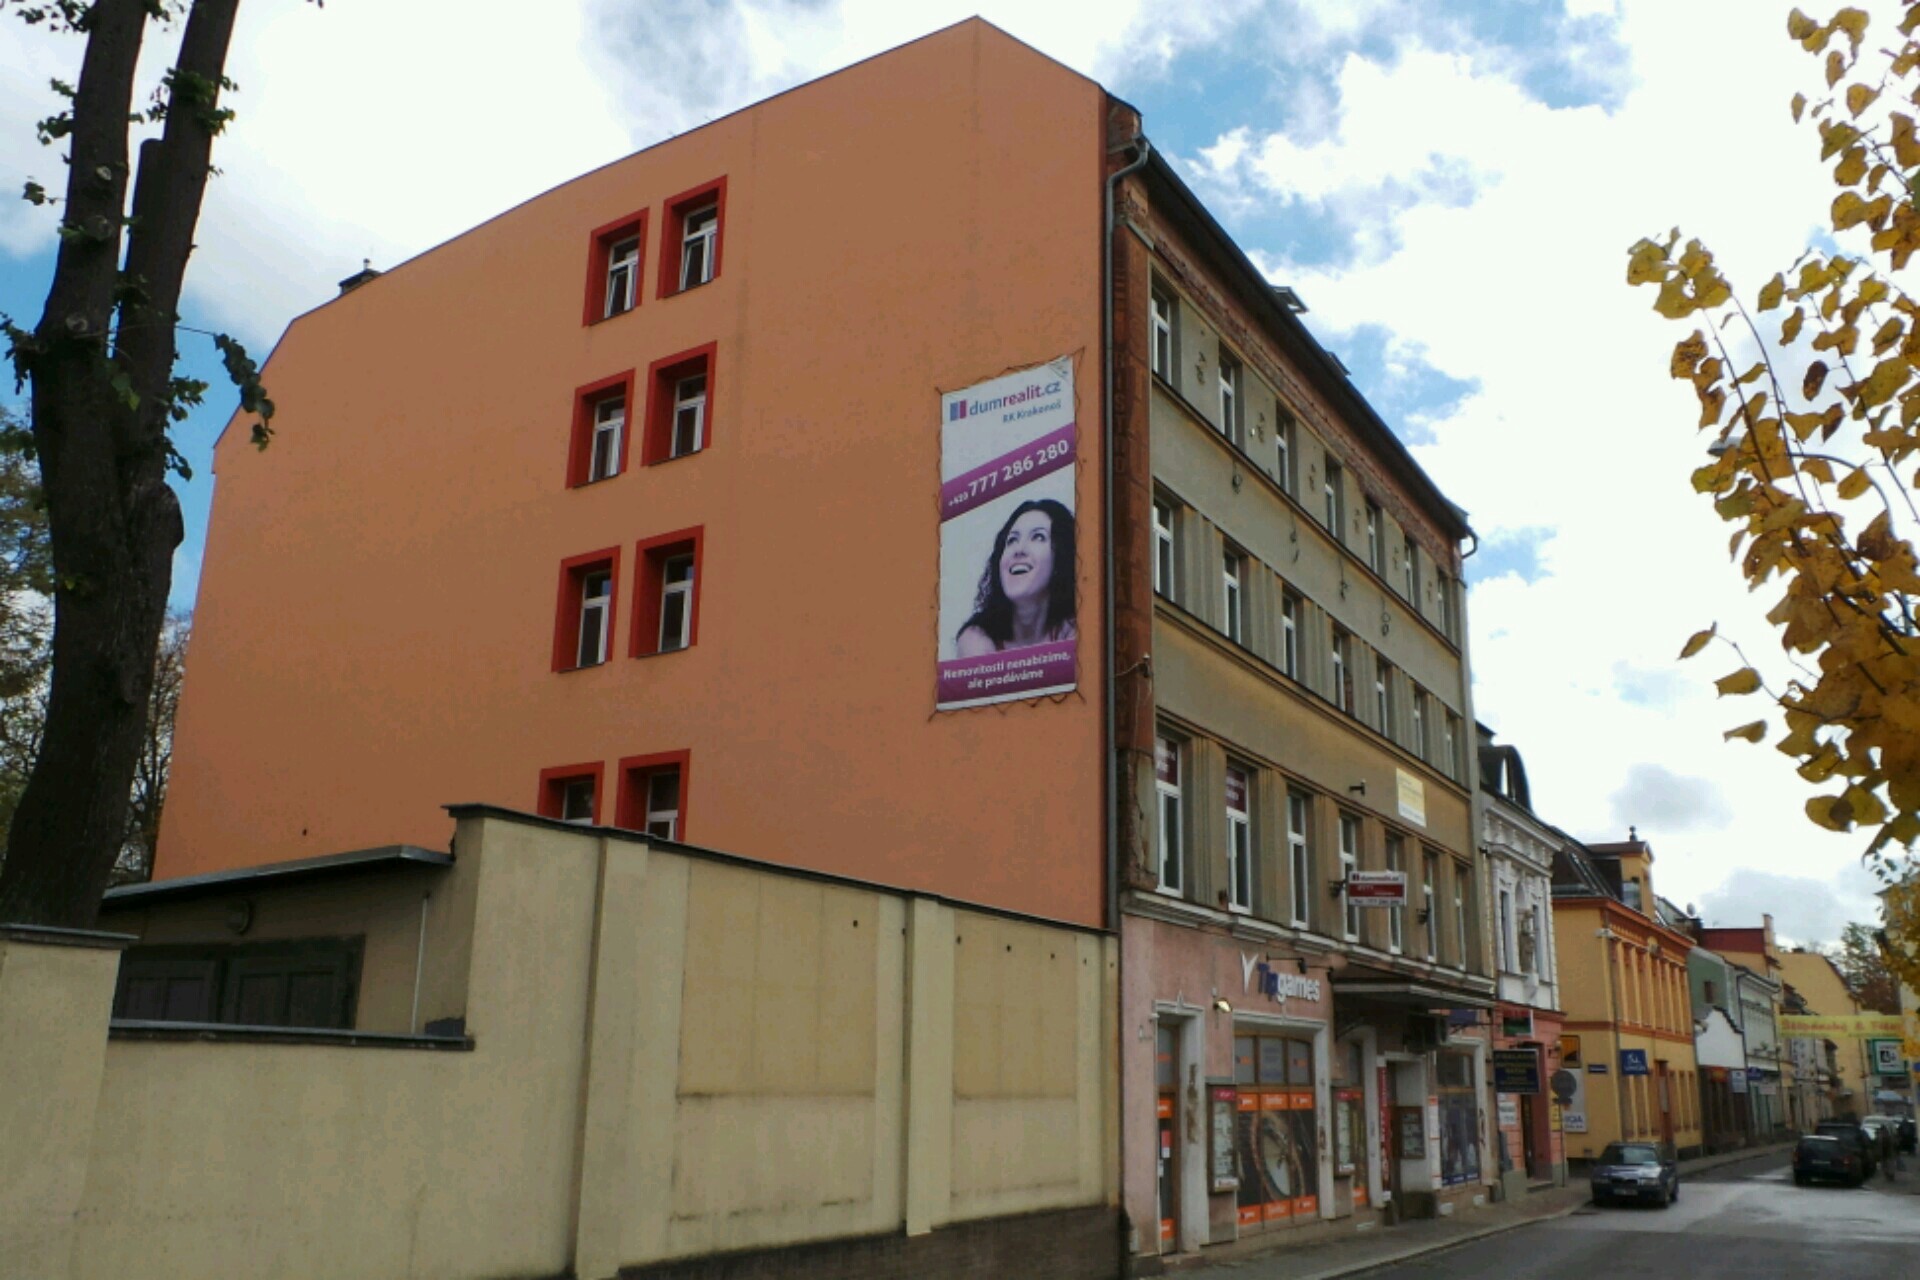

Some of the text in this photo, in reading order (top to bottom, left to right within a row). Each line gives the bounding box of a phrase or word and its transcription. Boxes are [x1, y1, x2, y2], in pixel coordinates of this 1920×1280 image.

[969, 381, 1061, 416] dumrealit.cz
[968, 471, 998, 497] 777
[1002, 456, 1034, 481] 286
[1036, 439, 1069, 466] 280
[944, 661, 1004, 680] Nemovitosti
[967, 669, 1044, 690] ale prodáváme
